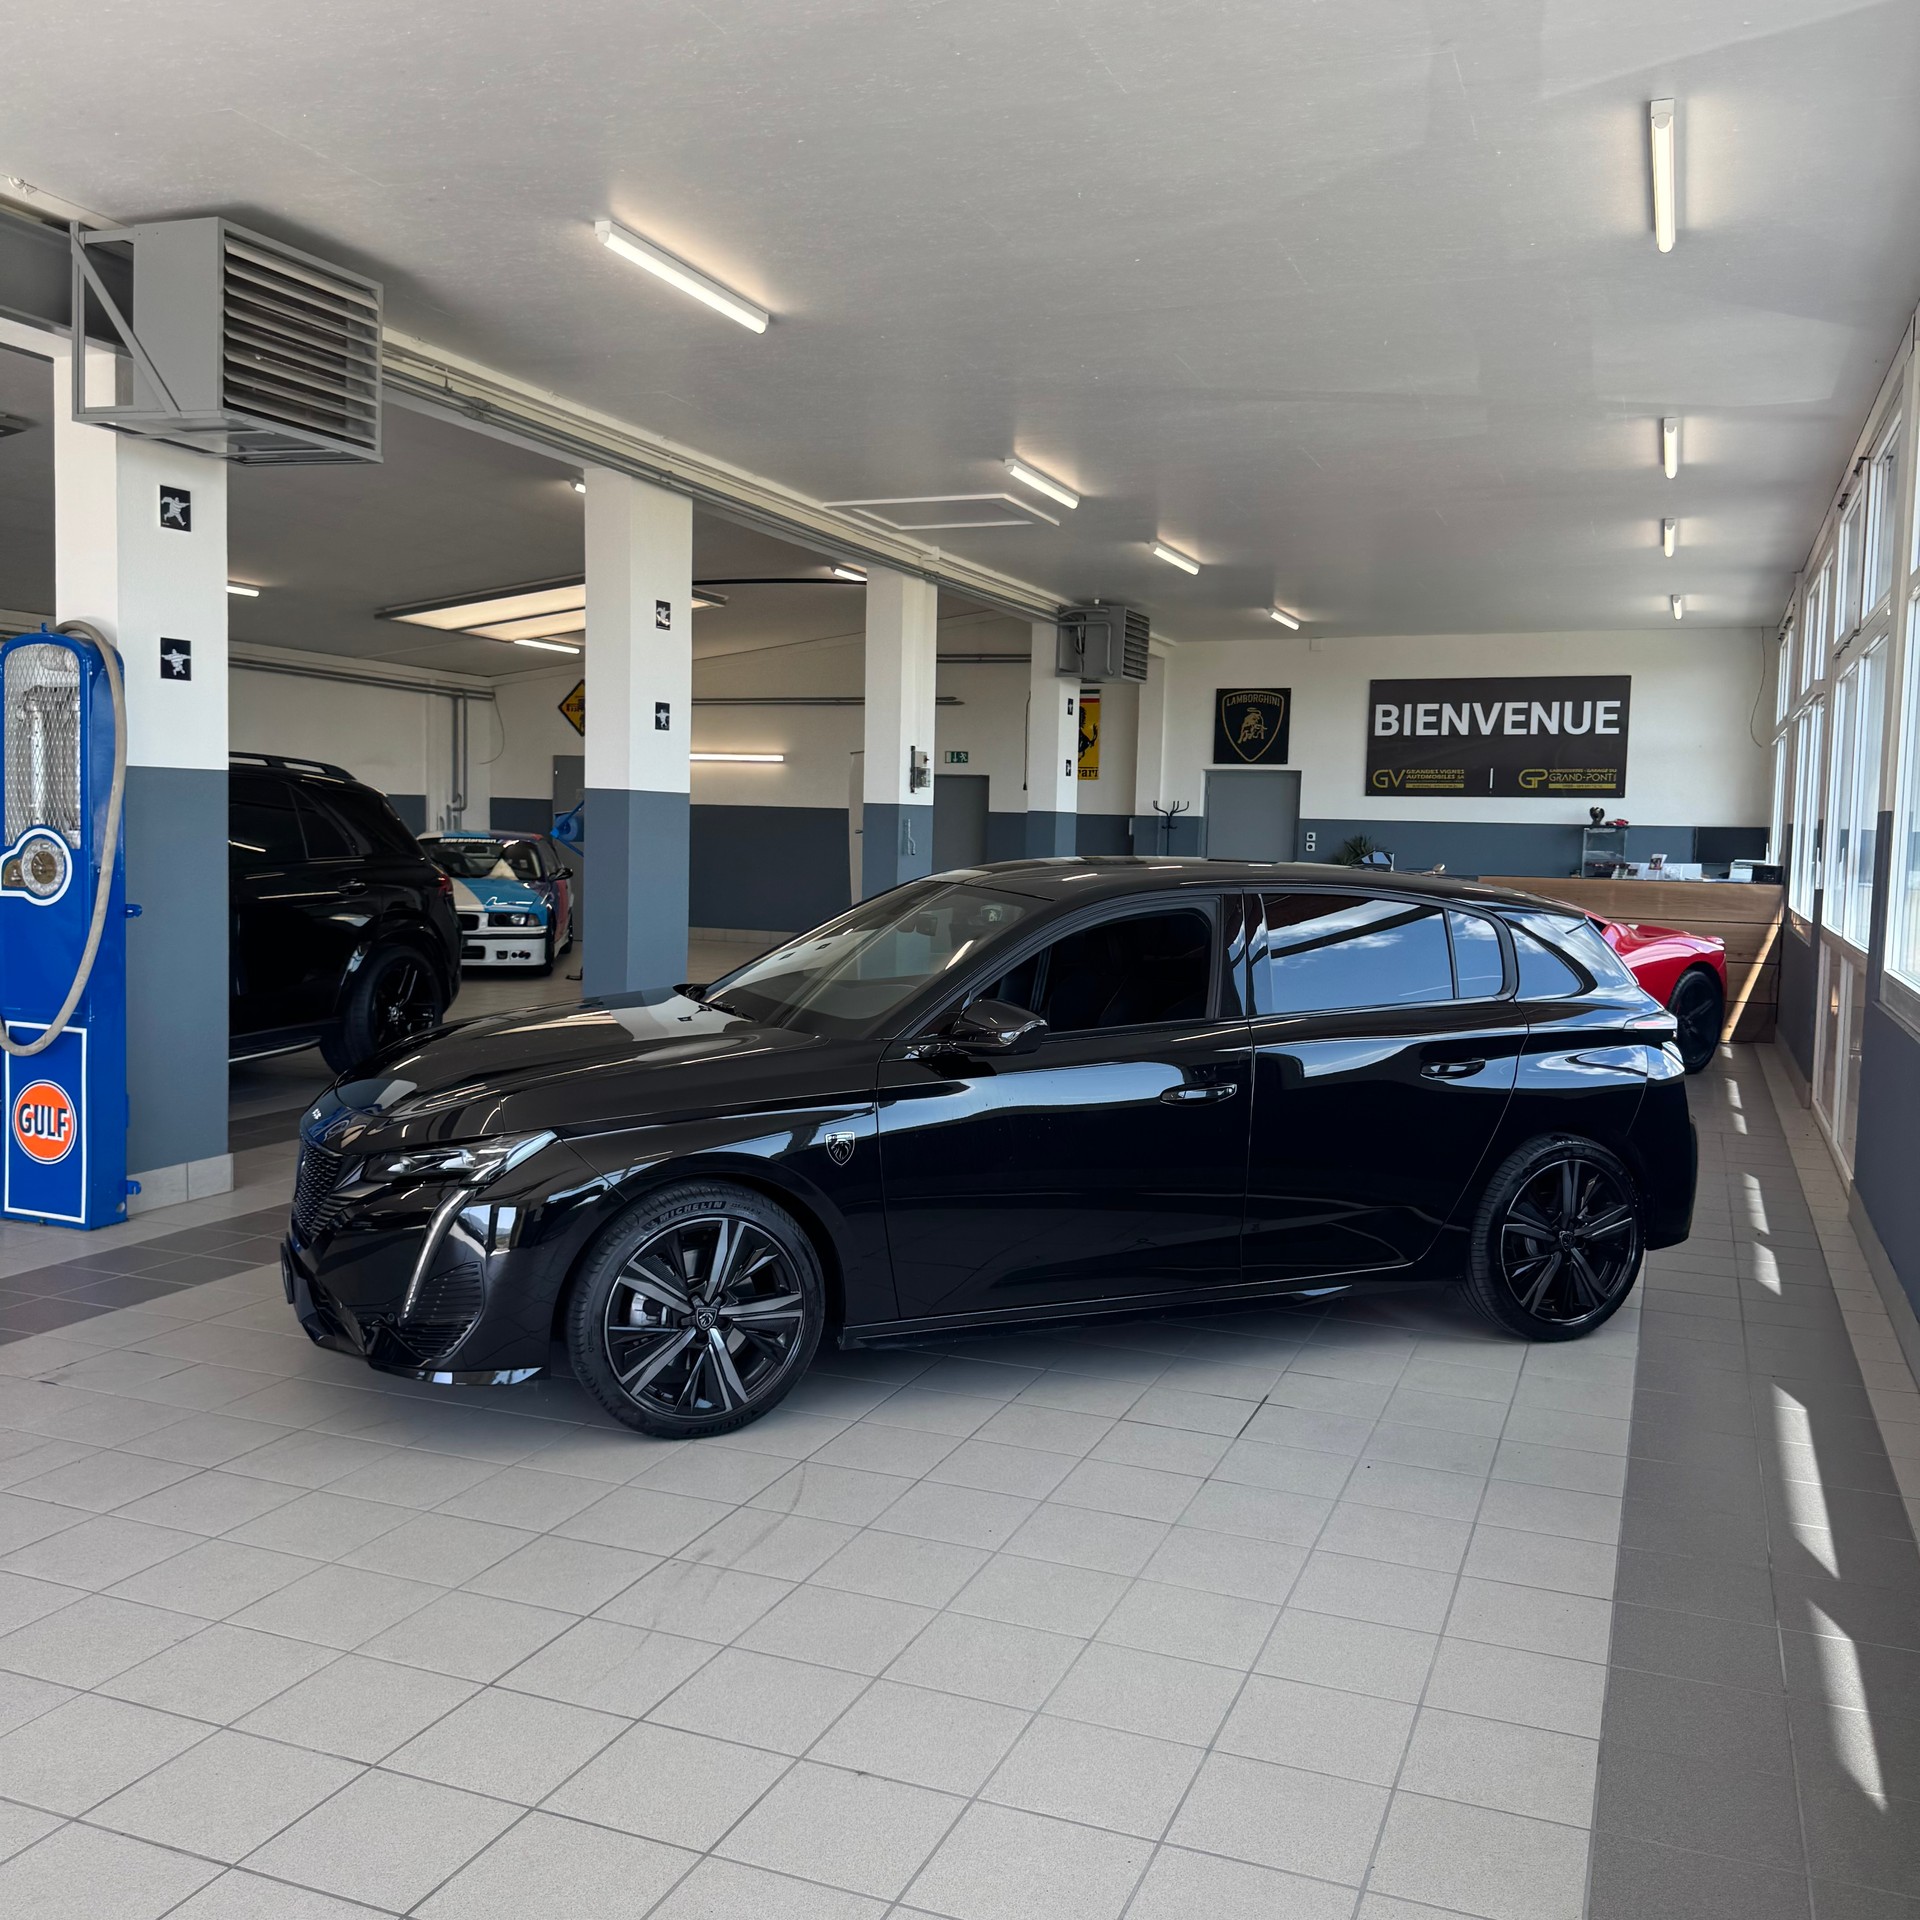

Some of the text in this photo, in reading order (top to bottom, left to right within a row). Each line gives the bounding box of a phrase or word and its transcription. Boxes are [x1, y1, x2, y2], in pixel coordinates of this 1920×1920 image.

[1226, 694, 1280, 707] LAMBORGHINI
[1374, 701, 1621, 736] BIENVENUE
[1372, 769, 1405, 788] GV
[19, 1103, 70, 1141] GULF
[659, 1201, 724, 1221] MICHELIN
